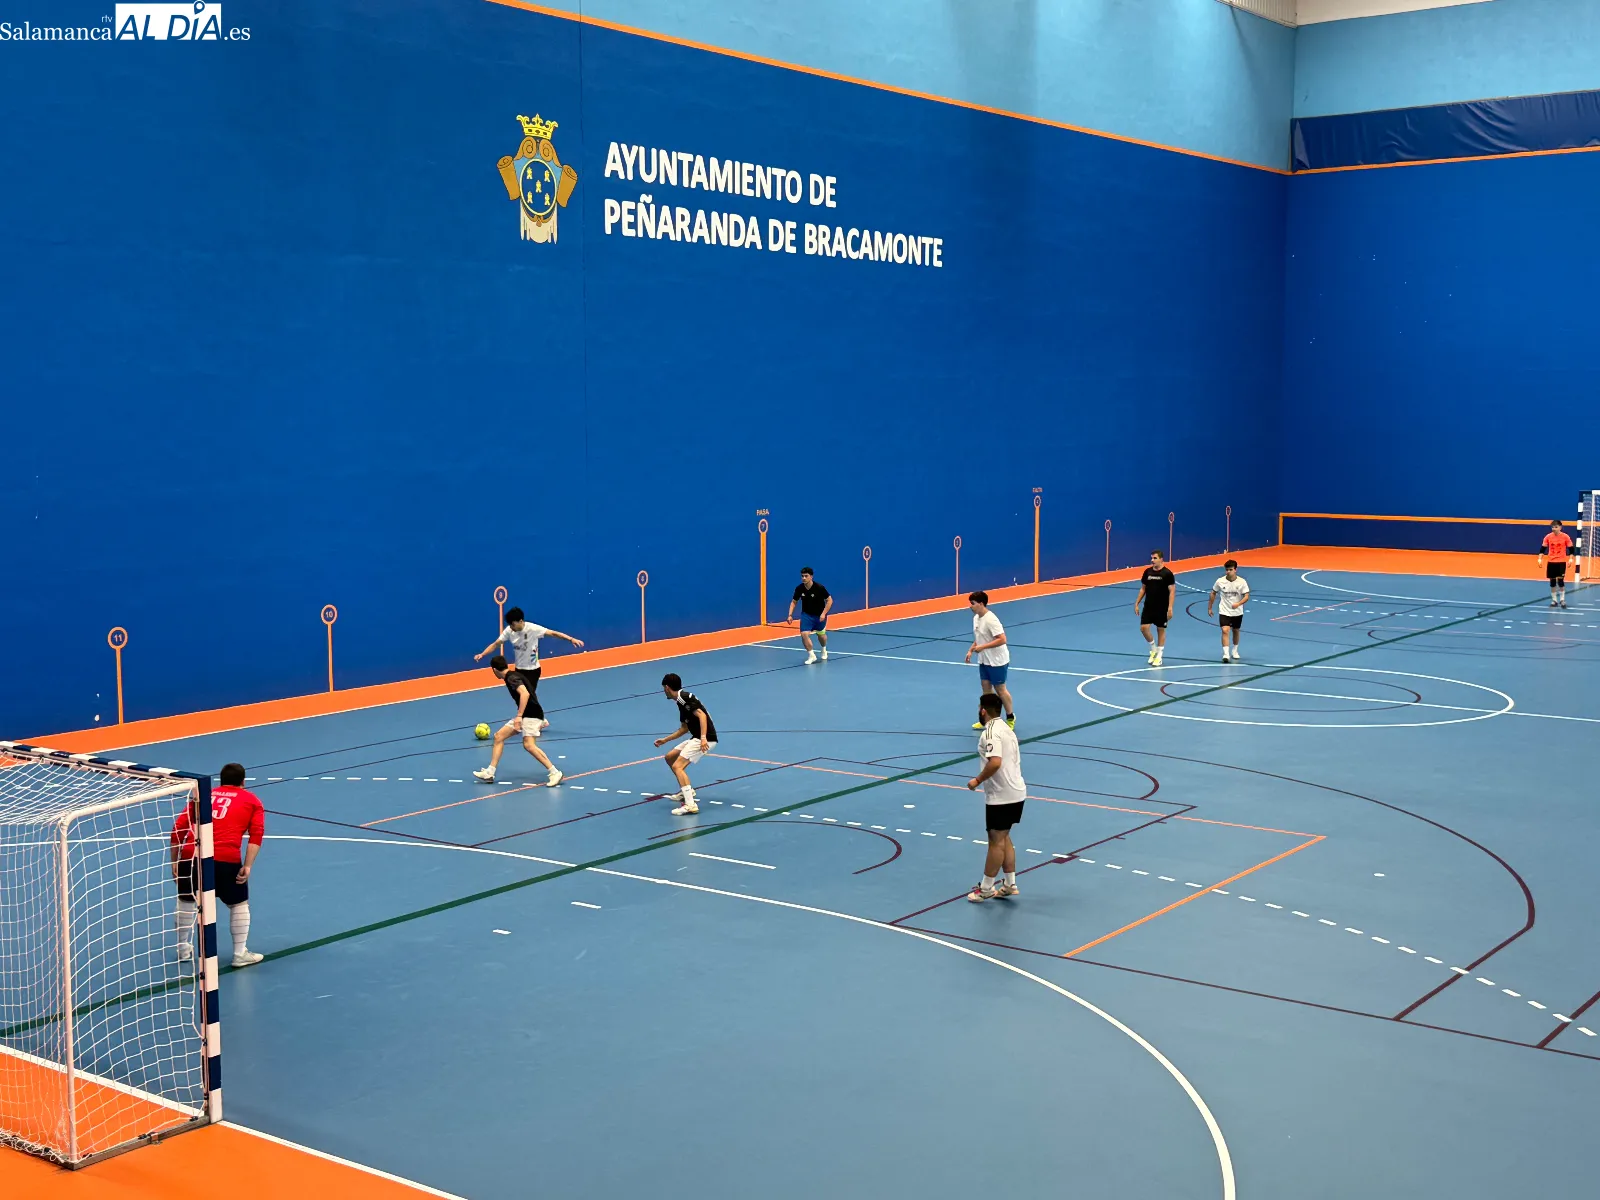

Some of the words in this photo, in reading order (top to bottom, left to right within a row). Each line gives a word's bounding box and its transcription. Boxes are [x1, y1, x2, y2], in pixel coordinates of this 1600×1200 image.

[604, 141, 802, 204] AYUNTAMIENTO
[809, 173, 837, 208] DE
[604, 193, 763, 250] PEÑARANDA
[768, 218, 797, 254] DE
[804, 223, 943, 268] BRACAMONTE
[113, 633, 123, 643] 11
